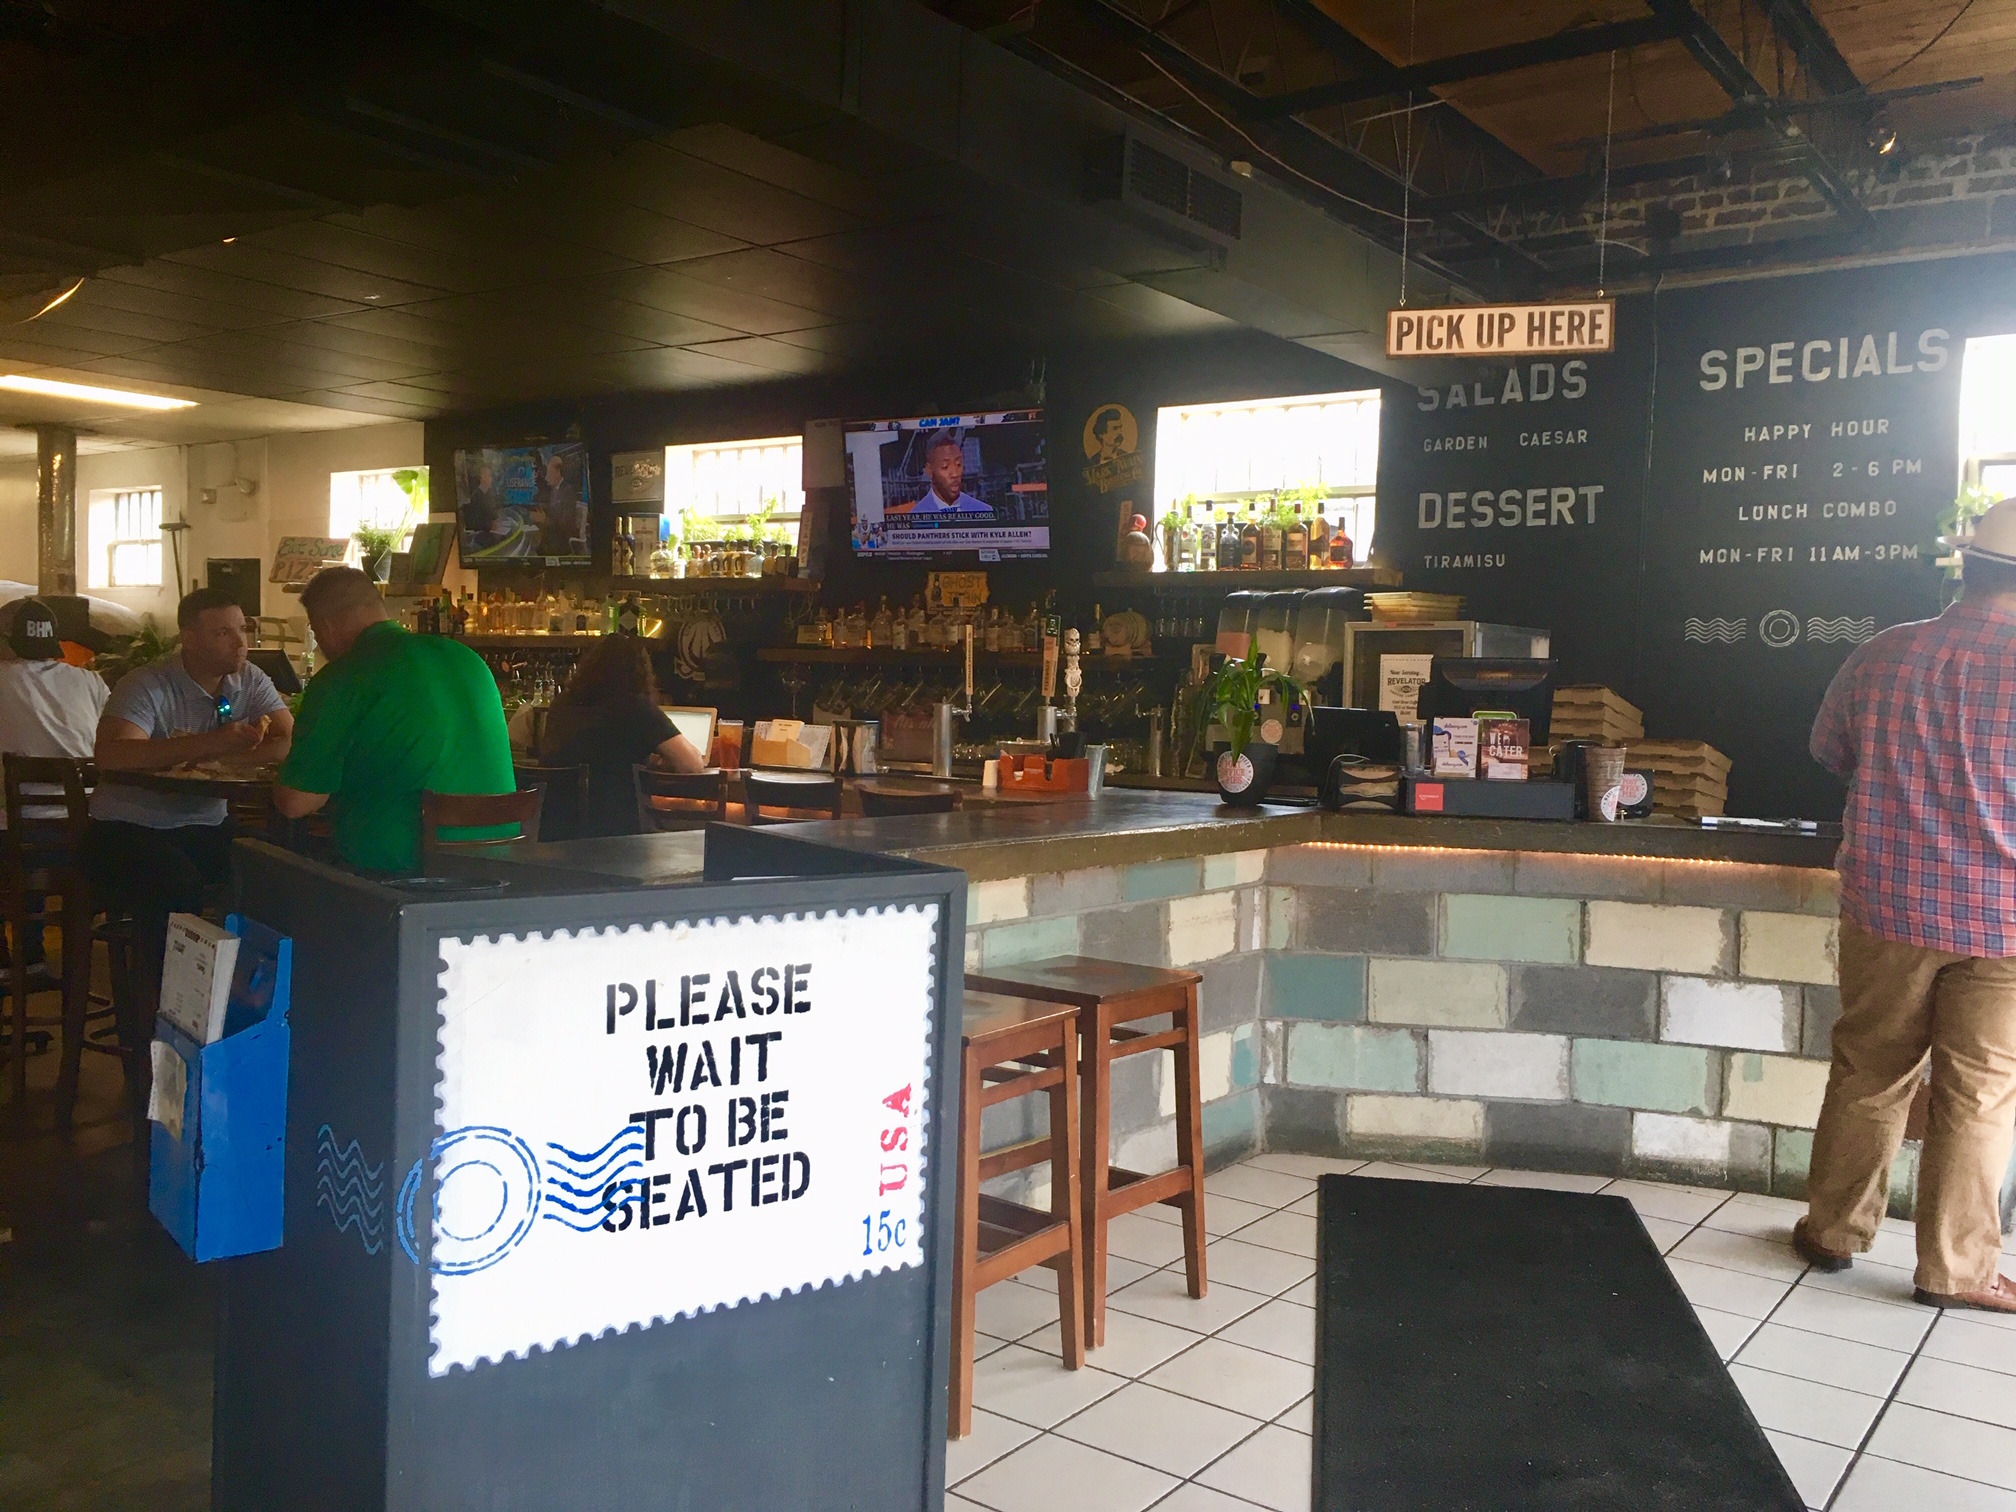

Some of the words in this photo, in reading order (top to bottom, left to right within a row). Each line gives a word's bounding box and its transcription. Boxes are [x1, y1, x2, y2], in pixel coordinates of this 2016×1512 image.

[1396, 313, 1465, 352] PICK
[1476, 312, 1516, 349] UP
[1526, 309, 1605, 348] HERE
[1699, 328, 1951, 391] SPECIALS
[1417, 360, 1588, 412] SALADS
[1423, 435, 1488, 452] GARDEN
[1519, 428, 1588, 447] CAESAR
[1744, 423, 1812, 443] HAPPY
[1831, 419, 1890, 437] HOUR
[1892, 458, 1922, 475] PM
[1418, 484, 1604, 530] DESSERT
[1739, 502, 1809, 522] LUNCH
[1823, 499, 1898, 518] COMBO
[309, 538, 345, 558] Some
[892, 532, 917, 540] SHOULD
[917, 532, 950, 540] PANTHERS
[1424, 553, 1507, 569] TIRAMISU
[27, 620, 53, 638] BHM
[1489, 745, 1524, 758] CATER
[606, 963, 812, 1034] PLEASE
[646, 1031, 783, 1096] WAIT
[629, 1103, 707, 1161] TO
[728, 1090, 790, 1148] BE
[879, 1082, 913, 1197] USA
[601, 1151, 811, 1232] SEATED
[862, 1210, 907, 1257] 15c
